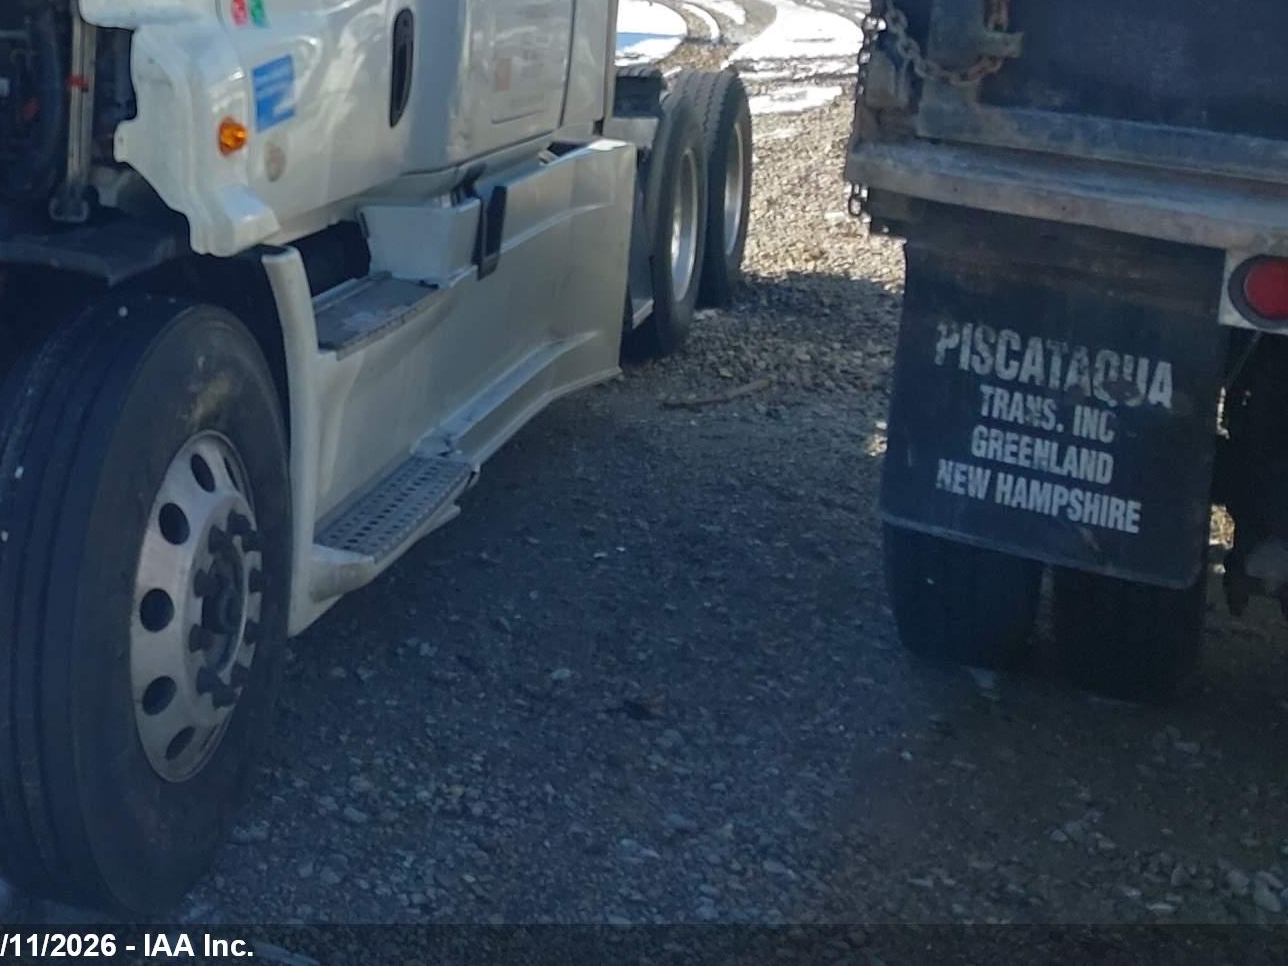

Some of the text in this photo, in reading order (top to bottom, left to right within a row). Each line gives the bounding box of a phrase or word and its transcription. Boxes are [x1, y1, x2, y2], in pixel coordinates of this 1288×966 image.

[934, 321, 1173, 409] PISCATAQUA
[979, 385, 1064, 432] TRANS.
[971, 425, 1113, 485] GREENLAND
[935, 459, 1142, 533] NEW HAMPSHIRE
